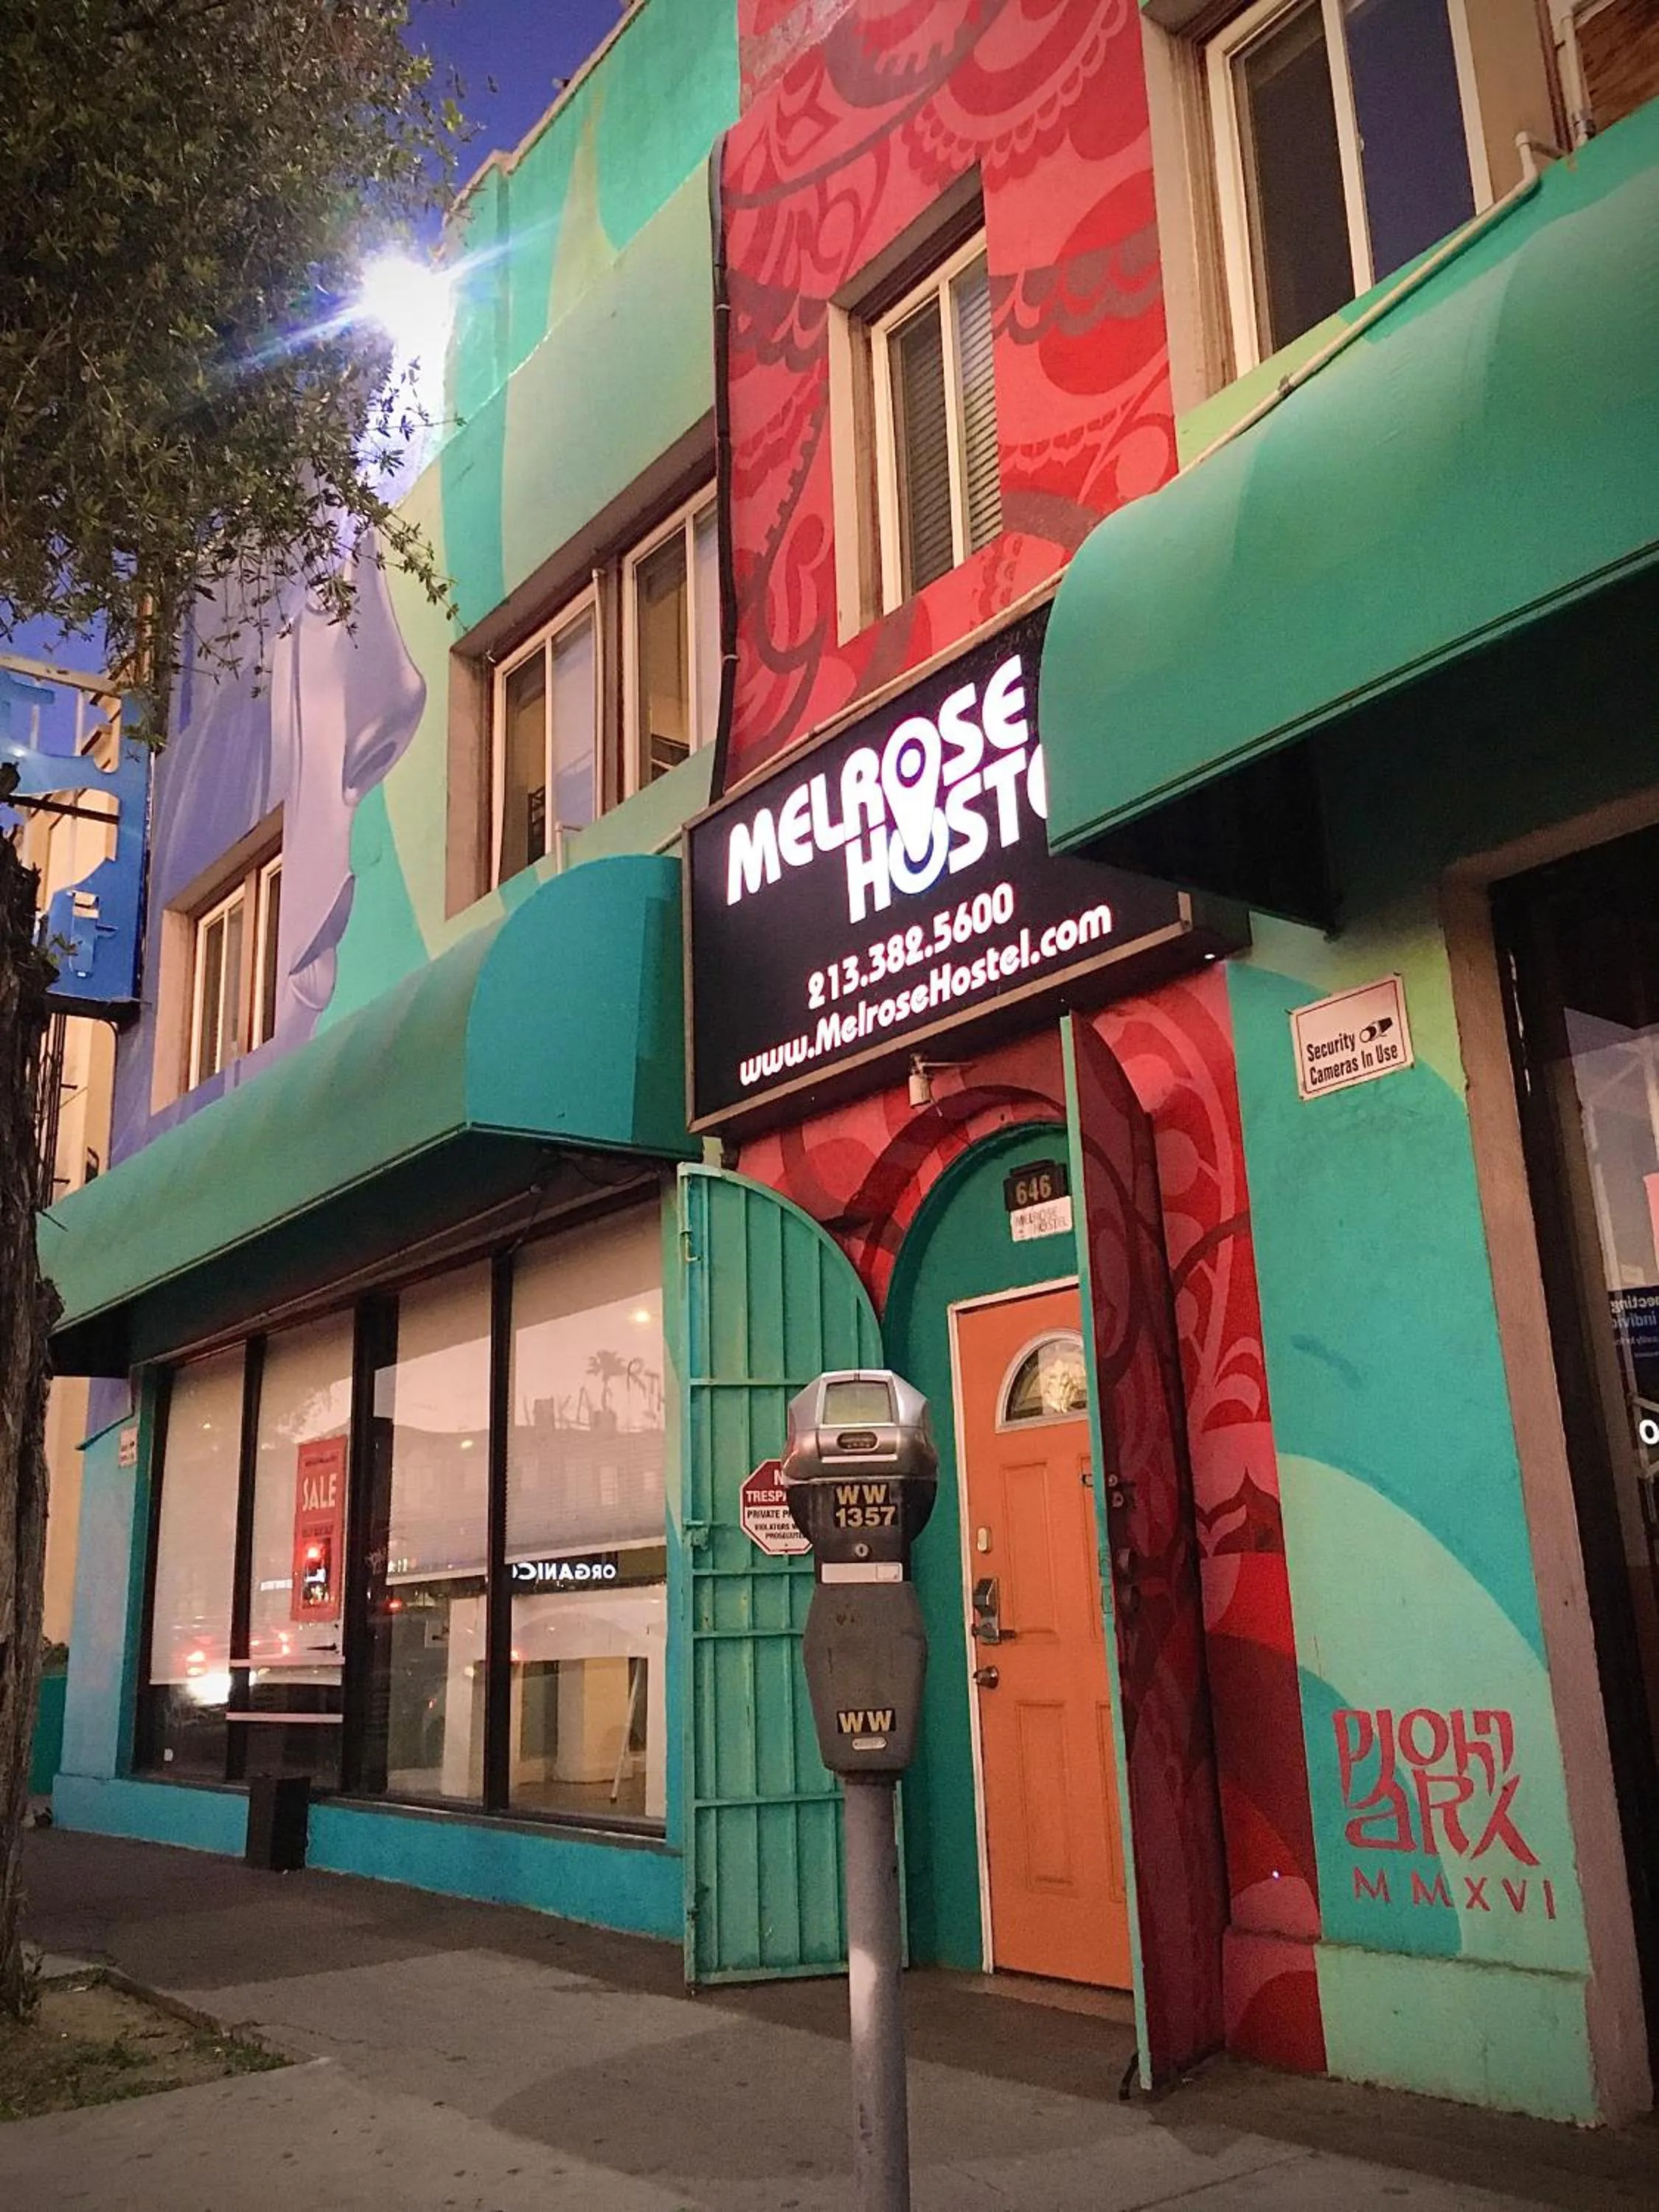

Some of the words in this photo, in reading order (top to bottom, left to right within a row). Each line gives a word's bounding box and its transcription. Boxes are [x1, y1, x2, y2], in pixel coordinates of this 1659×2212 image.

[727, 654, 1029, 906] MELROSE
[844, 742, 1048, 925] HOST
[808, 882, 1014, 1009] 213.382.5600
[740, 904, 1113, 1086] www.MelroseHostel.com
[1307, 1033, 1355, 1062] Security
[1310, 1057, 1359, 1085] Cameras
[1361, 1050, 1374, 1068] In
[1376, 1044, 1399, 1063] Use
[1016, 1175, 1052, 1205] 646
[302, 1473, 337, 1512] SALE
[747, 1509, 779, 1518] PRIVATE
[835, 1506, 896, 1528] 1357
